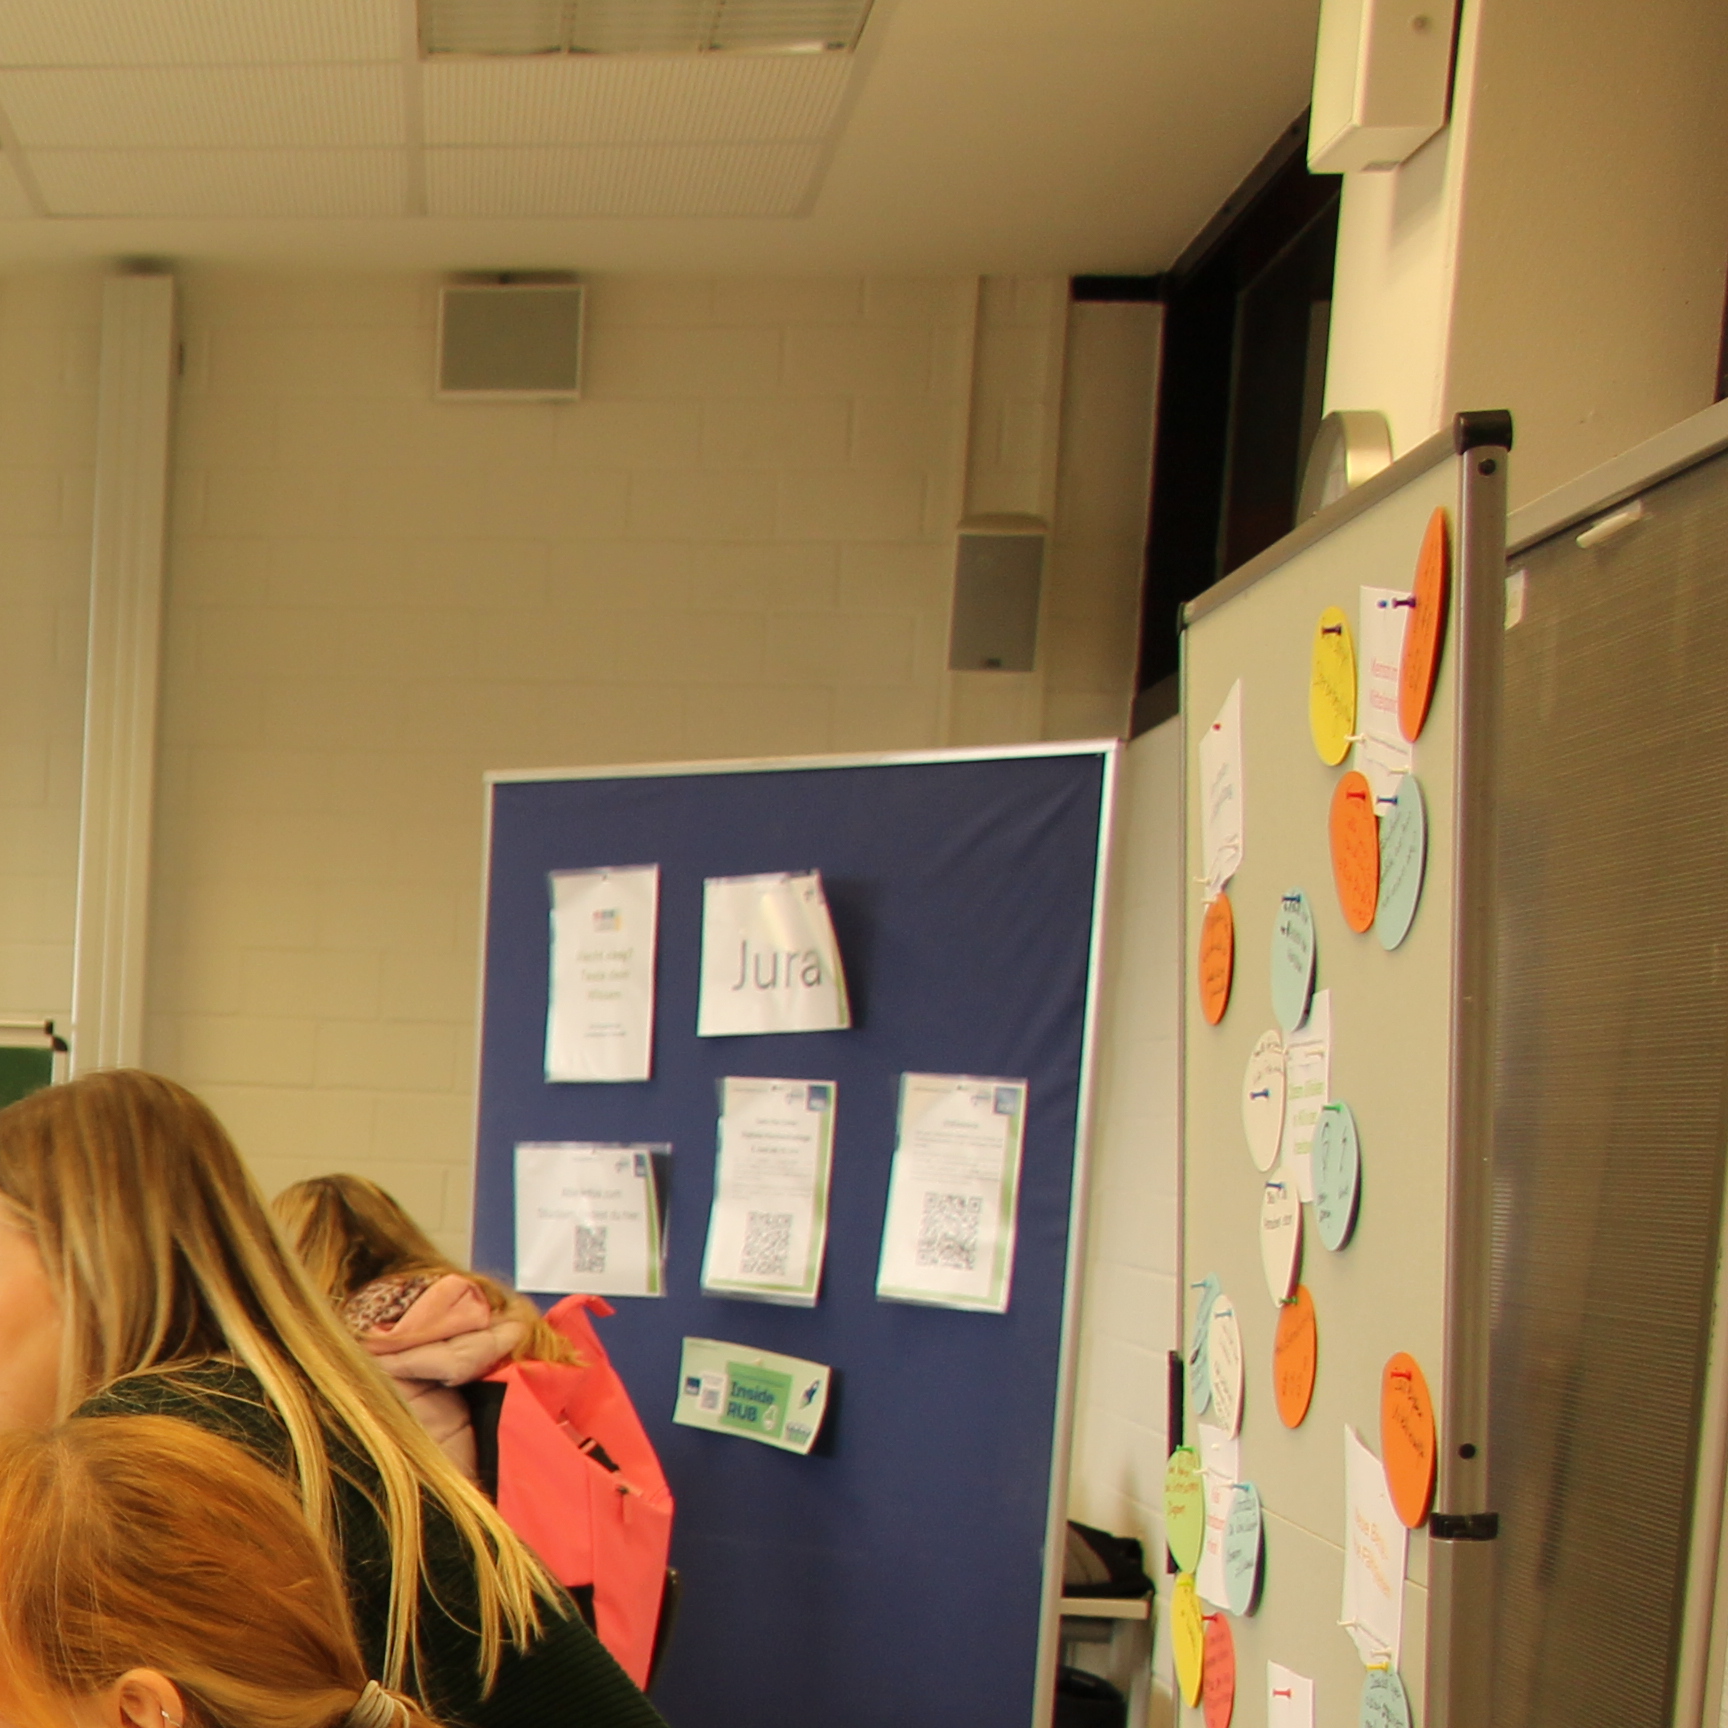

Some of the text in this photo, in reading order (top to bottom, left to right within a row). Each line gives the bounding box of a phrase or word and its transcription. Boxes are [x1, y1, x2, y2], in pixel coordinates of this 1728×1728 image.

[731, 940, 824, 992] Jura
[731, 1381, 775, 1405] Inside
[727, 1401, 758, 1422] RUB
